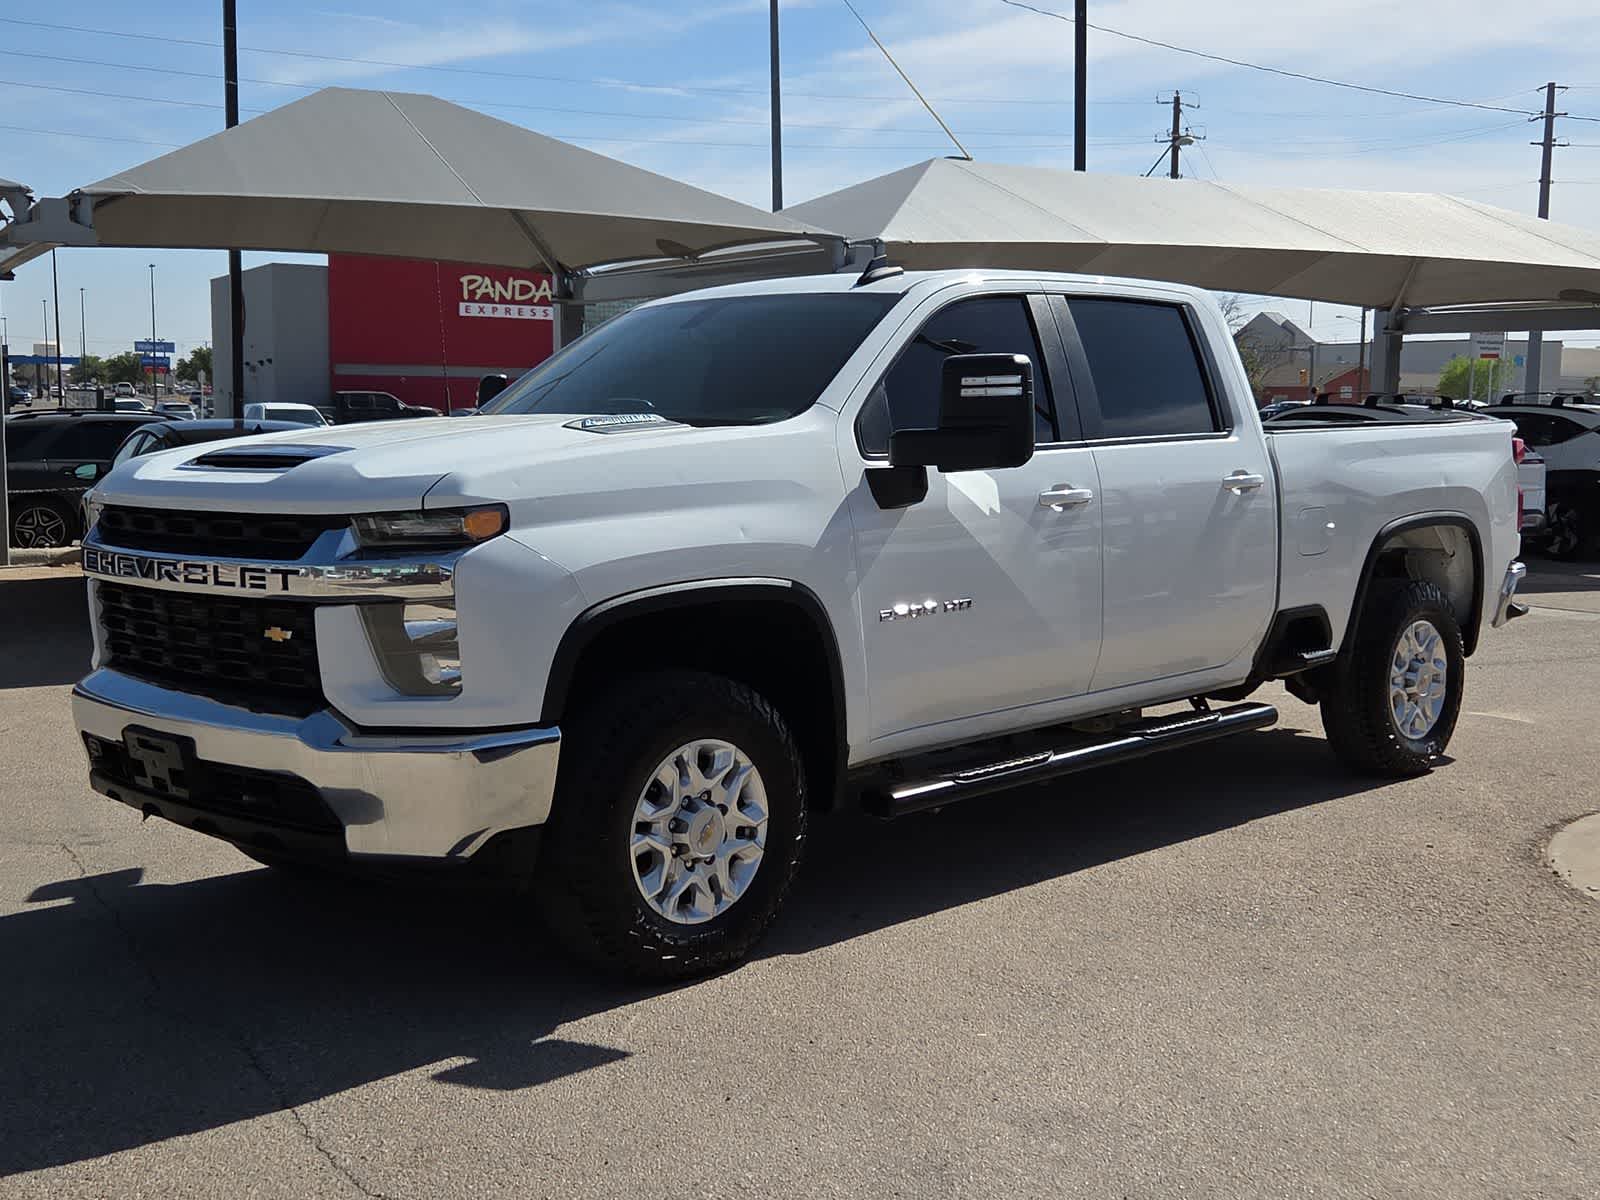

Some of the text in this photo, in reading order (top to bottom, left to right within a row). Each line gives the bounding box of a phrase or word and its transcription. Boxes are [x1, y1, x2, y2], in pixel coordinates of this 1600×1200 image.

[459, 275, 552, 303] PANDA
[464, 305, 550, 317] EXPRESS
[83, 550, 300, 592] CHEVROLET
